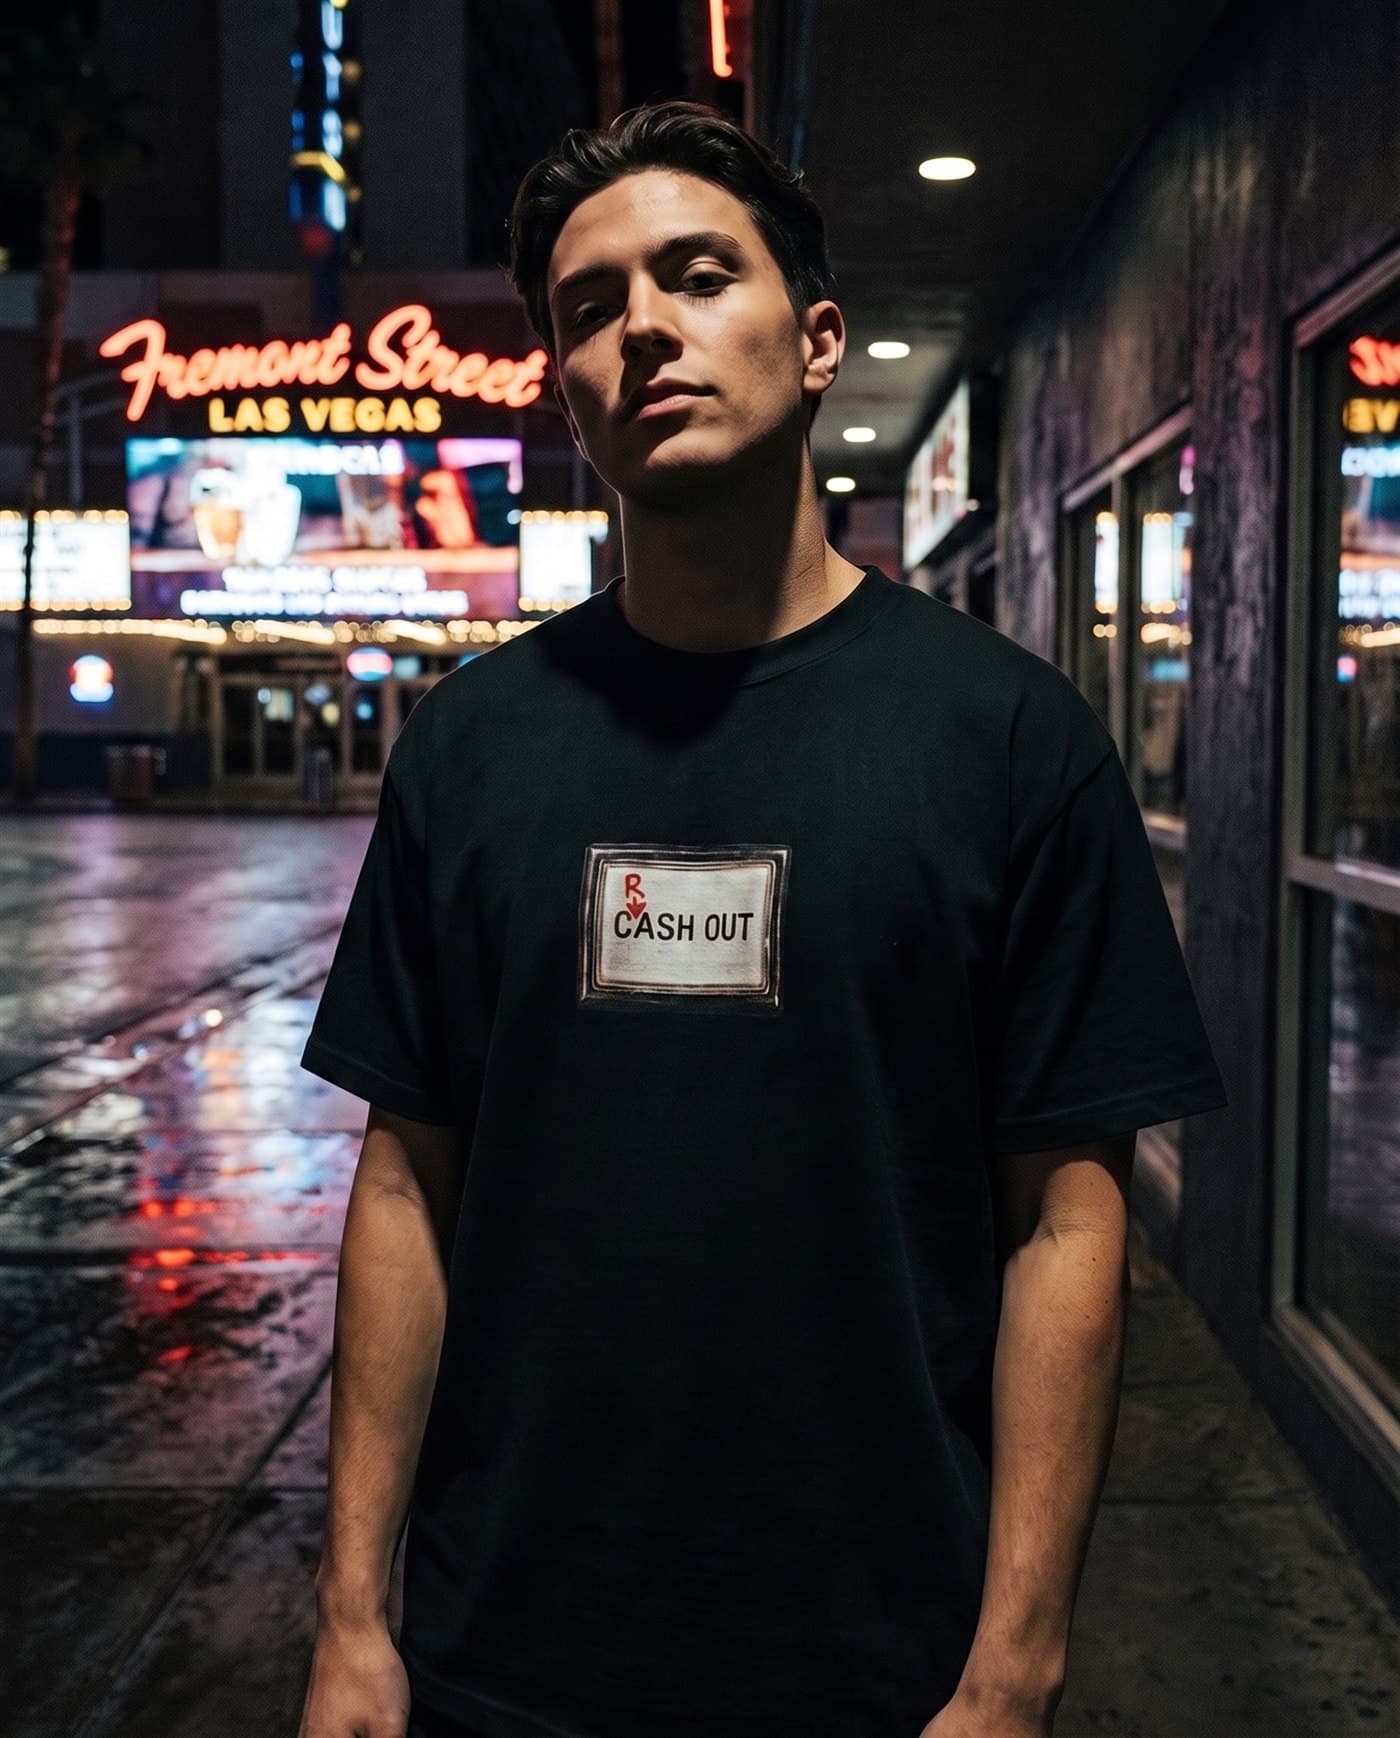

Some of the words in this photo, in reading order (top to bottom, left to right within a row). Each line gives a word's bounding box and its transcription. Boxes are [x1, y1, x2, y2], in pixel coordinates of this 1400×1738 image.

[100, 318, 351, 422] Fremont
[356, 304, 548, 408] Street
[208, 398, 290, 432] LAS
[301, 398, 442, 432] VEGAS
[625, 873, 646, 898] R
[614, 911, 694, 941] CASH
[705, 912, 754, 941] OUT
